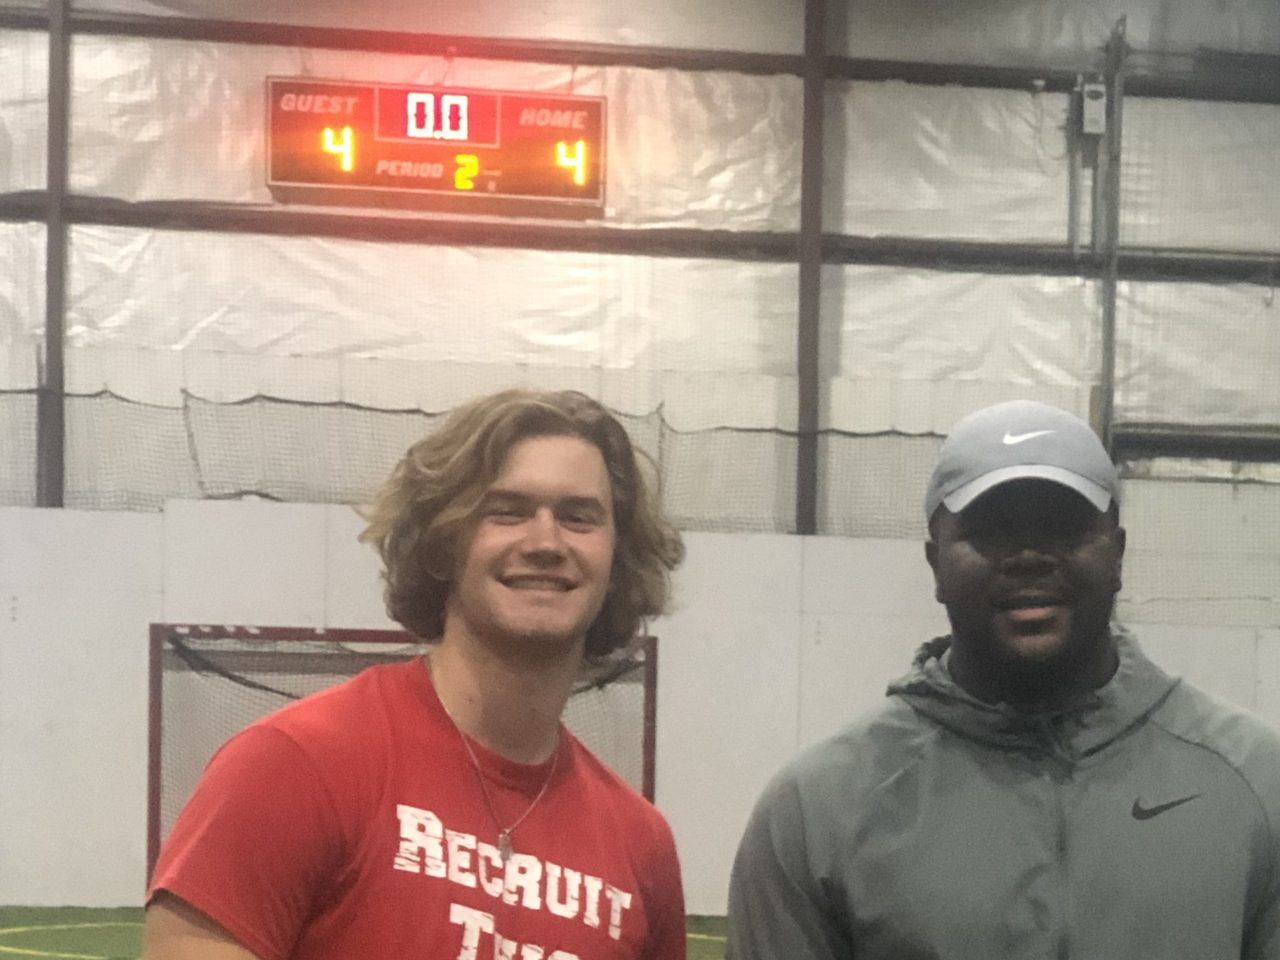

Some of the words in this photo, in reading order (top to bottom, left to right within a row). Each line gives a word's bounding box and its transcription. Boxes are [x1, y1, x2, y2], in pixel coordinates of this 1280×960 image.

[280, 92, 359, 115] GUEST
[519, 108, 588, 129] HOME
[322, 126, 354, 172] 4
[556, 140, 587, 186] 4
[376, 160, 444, 179] PERIOD
[454, 154, 480, 190] 2
[393, 803, 632, 940] RECRUIT
